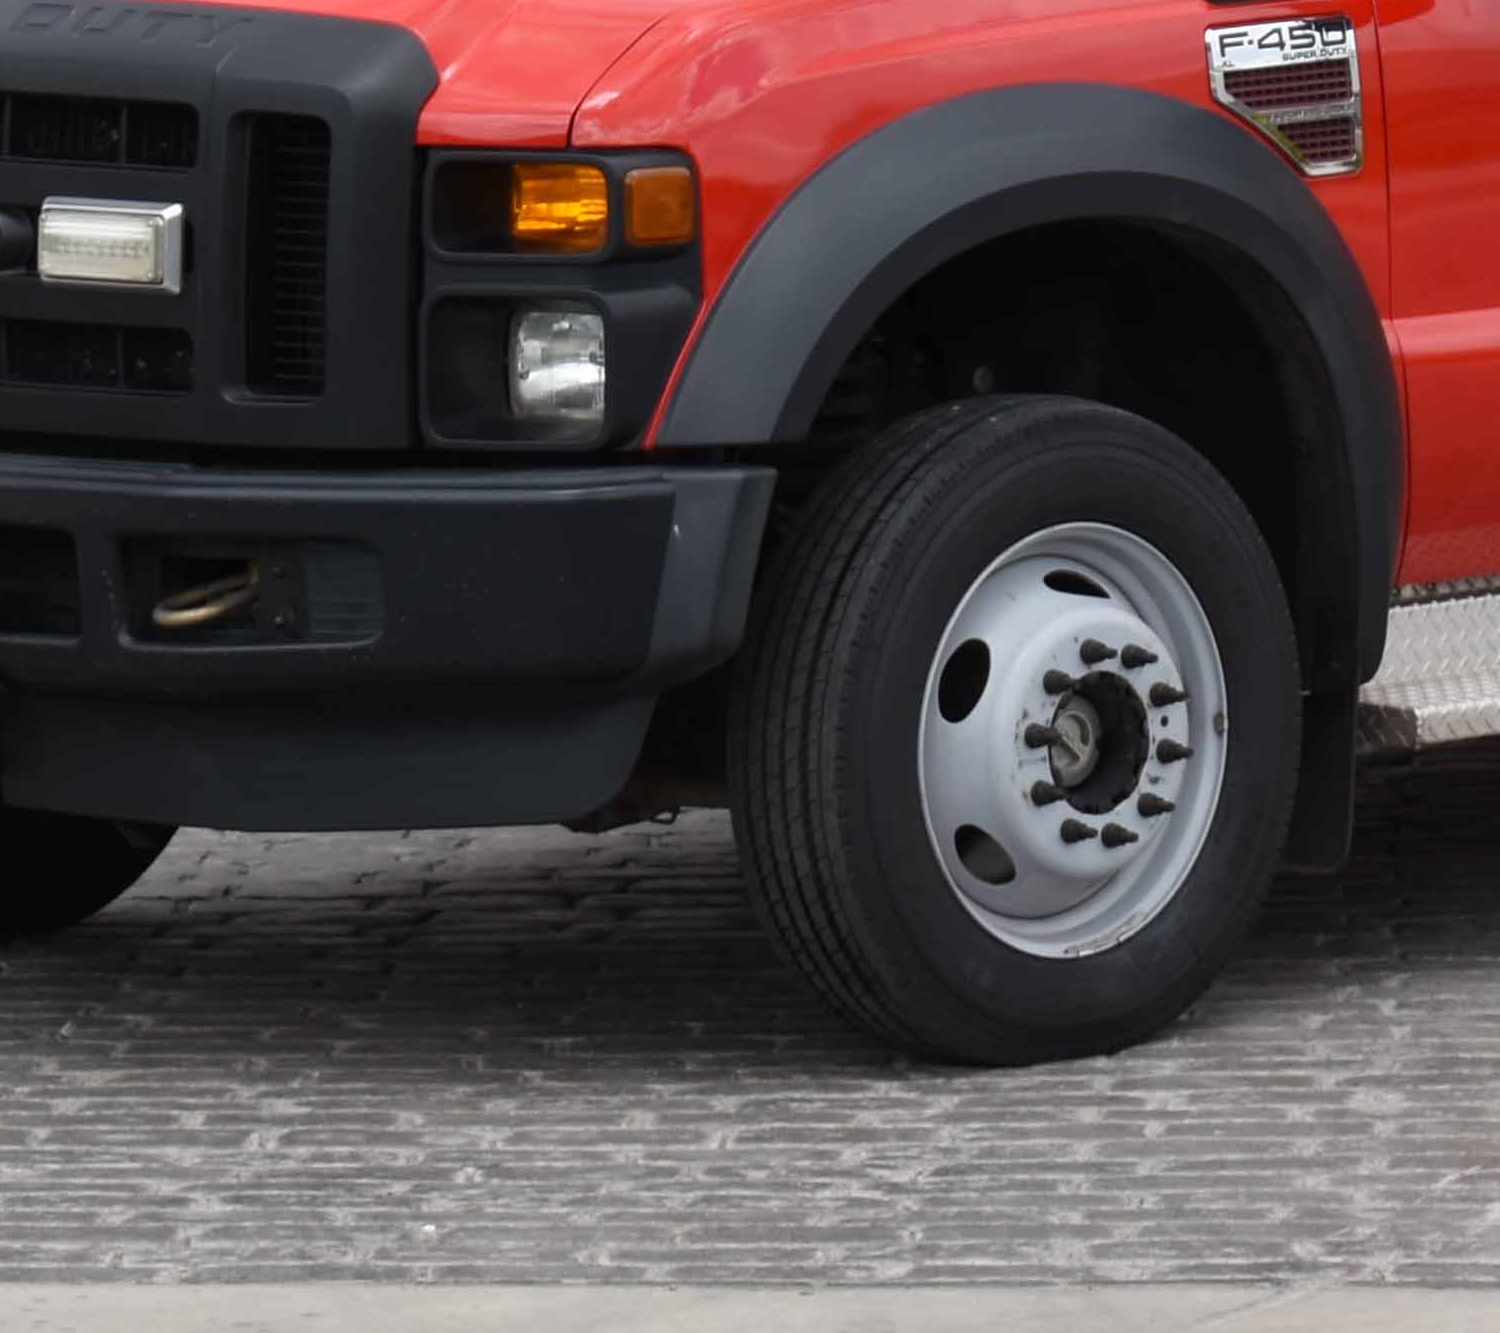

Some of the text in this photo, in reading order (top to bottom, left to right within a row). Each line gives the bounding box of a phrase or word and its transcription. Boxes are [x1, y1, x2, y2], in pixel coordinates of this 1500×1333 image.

[10, 1, 254, 47] DUTY
[1283, 46, 1348, 61] SUPER DUTY
